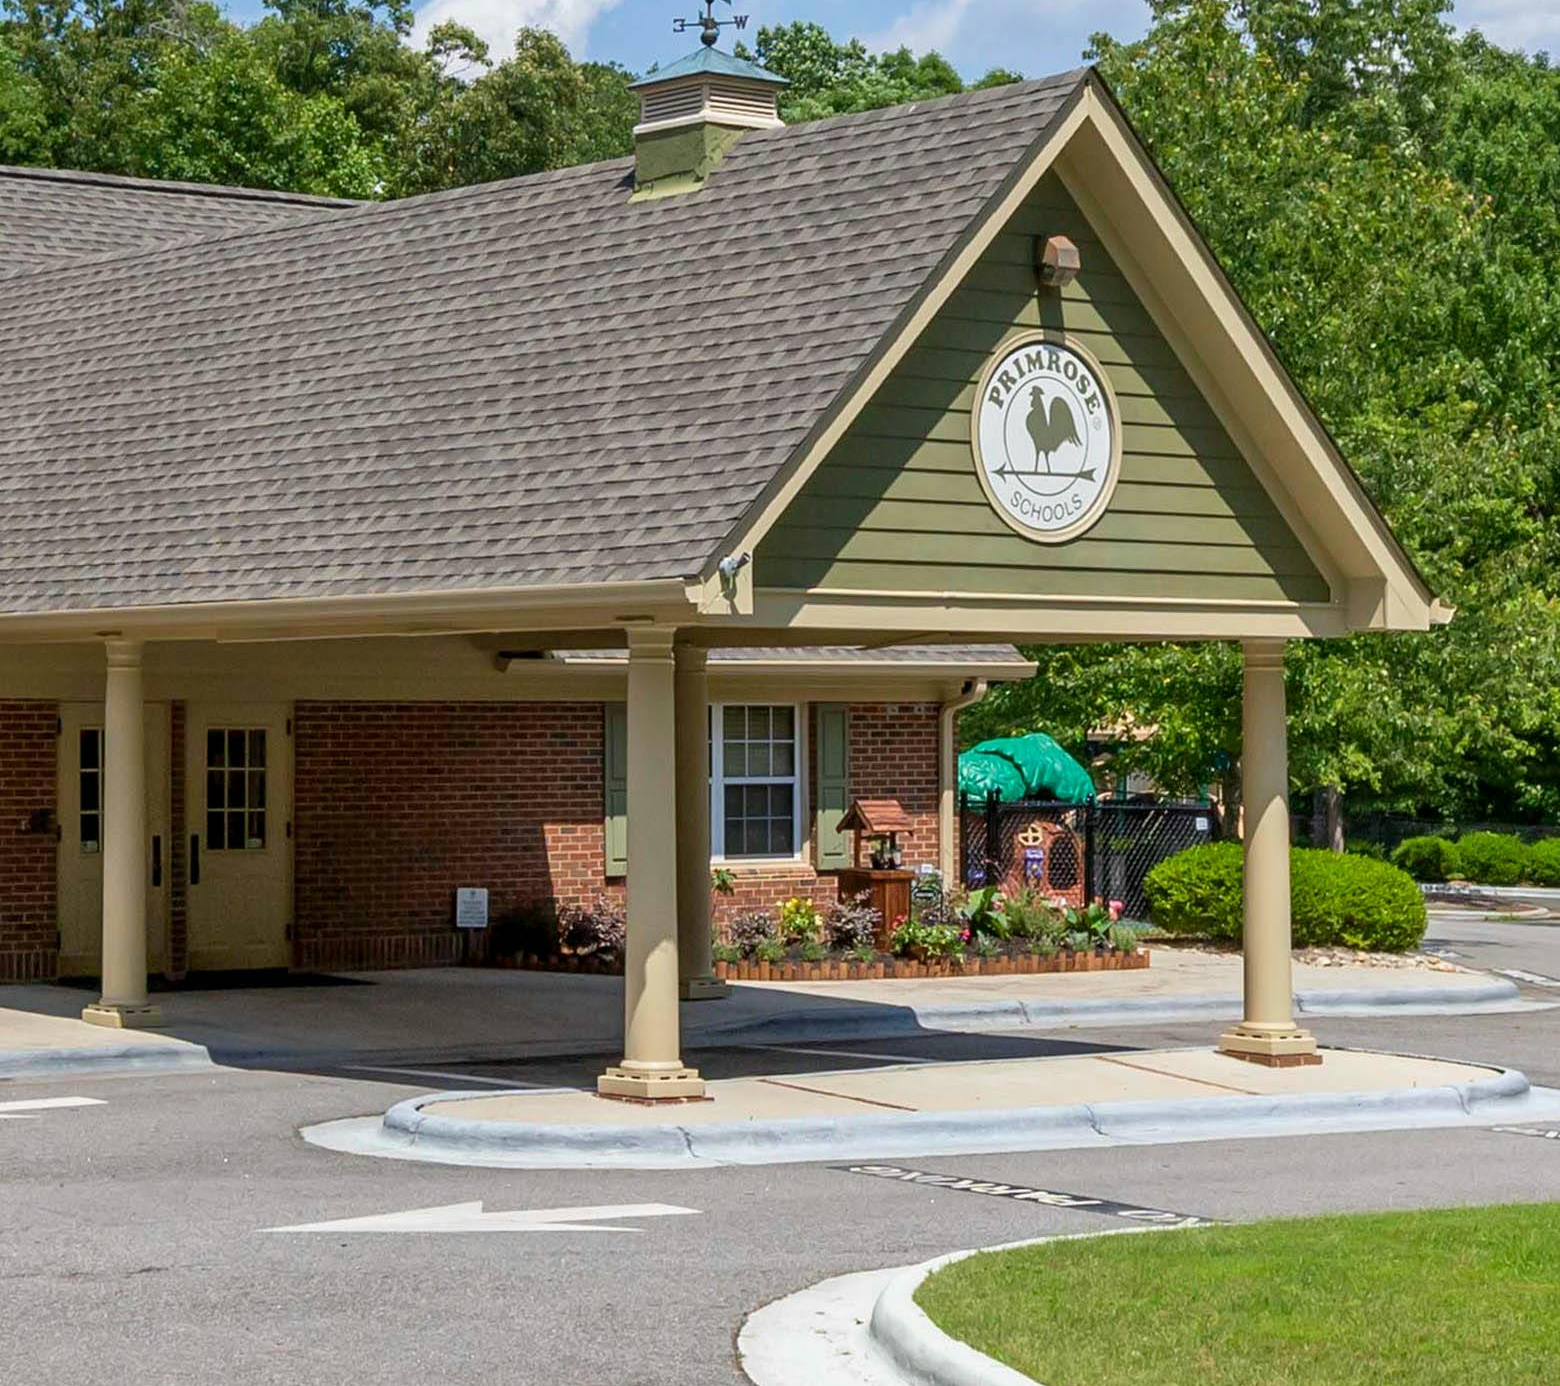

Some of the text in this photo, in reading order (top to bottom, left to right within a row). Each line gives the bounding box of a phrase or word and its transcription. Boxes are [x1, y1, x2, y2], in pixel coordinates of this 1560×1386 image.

[734, 15, 749, 29] W
[988, 349, 1101, 415] PRIMROSE
[1010, 490, 1083, 523] SCHOOLS
[849, 1165, 1103, 1206] PARKING
